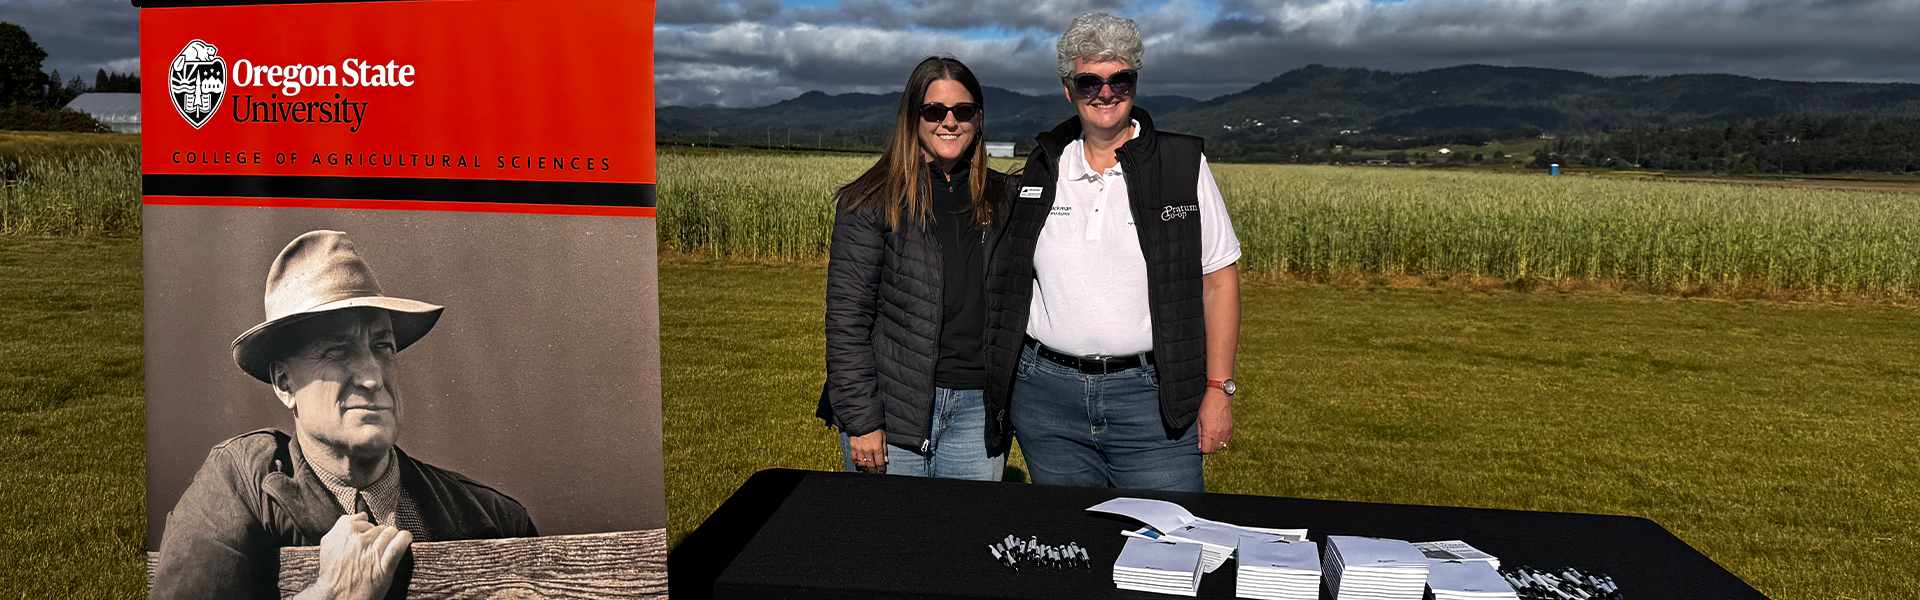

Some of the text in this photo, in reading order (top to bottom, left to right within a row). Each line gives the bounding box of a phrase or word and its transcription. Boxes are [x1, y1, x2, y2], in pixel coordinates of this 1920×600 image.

[233, 57, 415, 96] Oregon State
[232, 93, 369, 134] University
[172, 150, 610, 171] COLLEGE OF AGRICULTURAL SCIENCES
[1161, 210, 1187, 221] Co-op
[1164, 204, 1197, 217] Pratum
